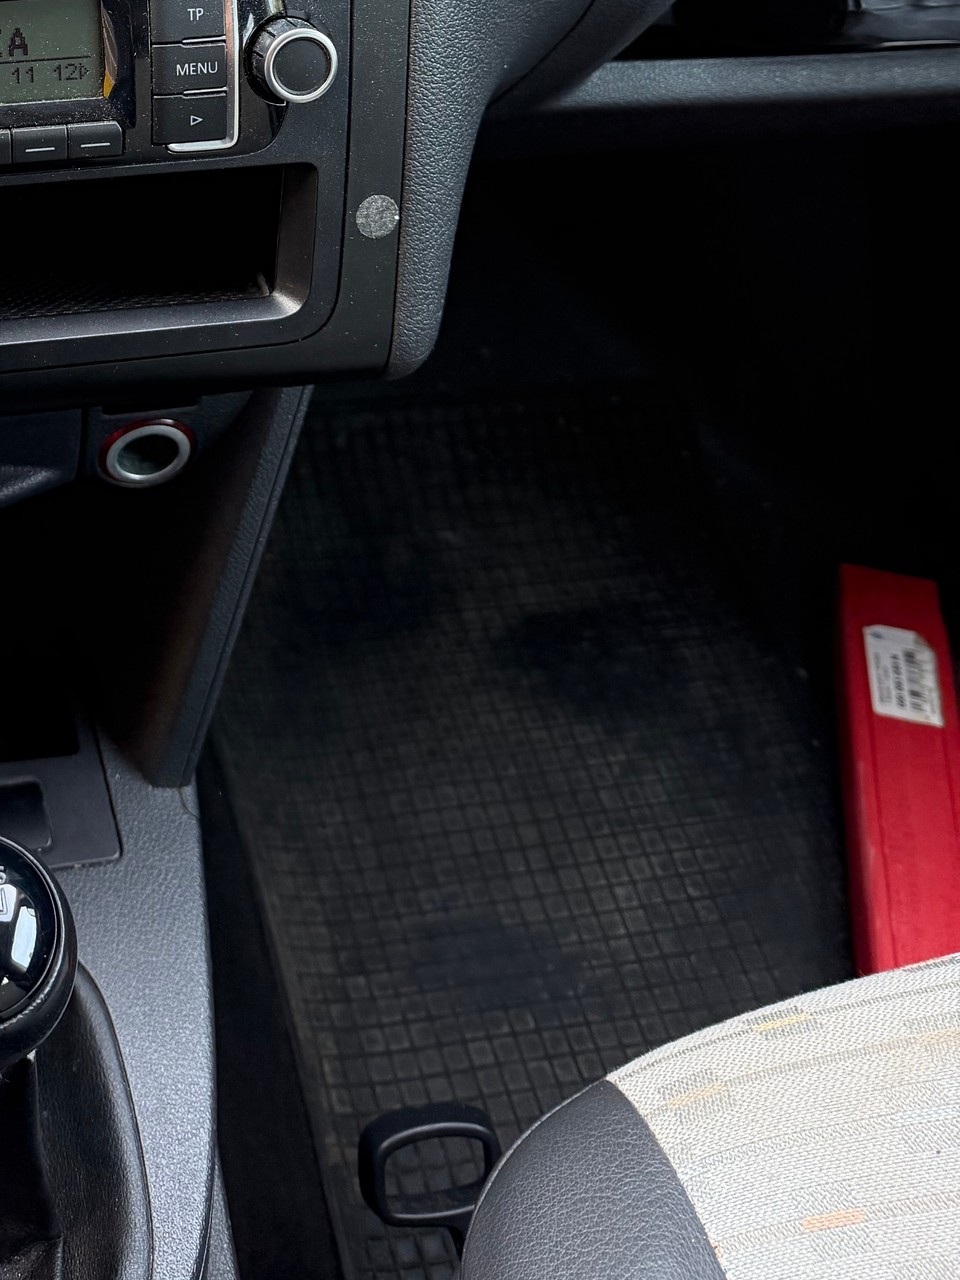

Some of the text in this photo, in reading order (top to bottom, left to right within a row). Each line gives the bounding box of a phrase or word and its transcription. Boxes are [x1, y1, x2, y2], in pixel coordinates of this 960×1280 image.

[187, 8, 204, 21] TP
[11, 66, 35, 85] 11
[176, 61, 218, 77] MENU
